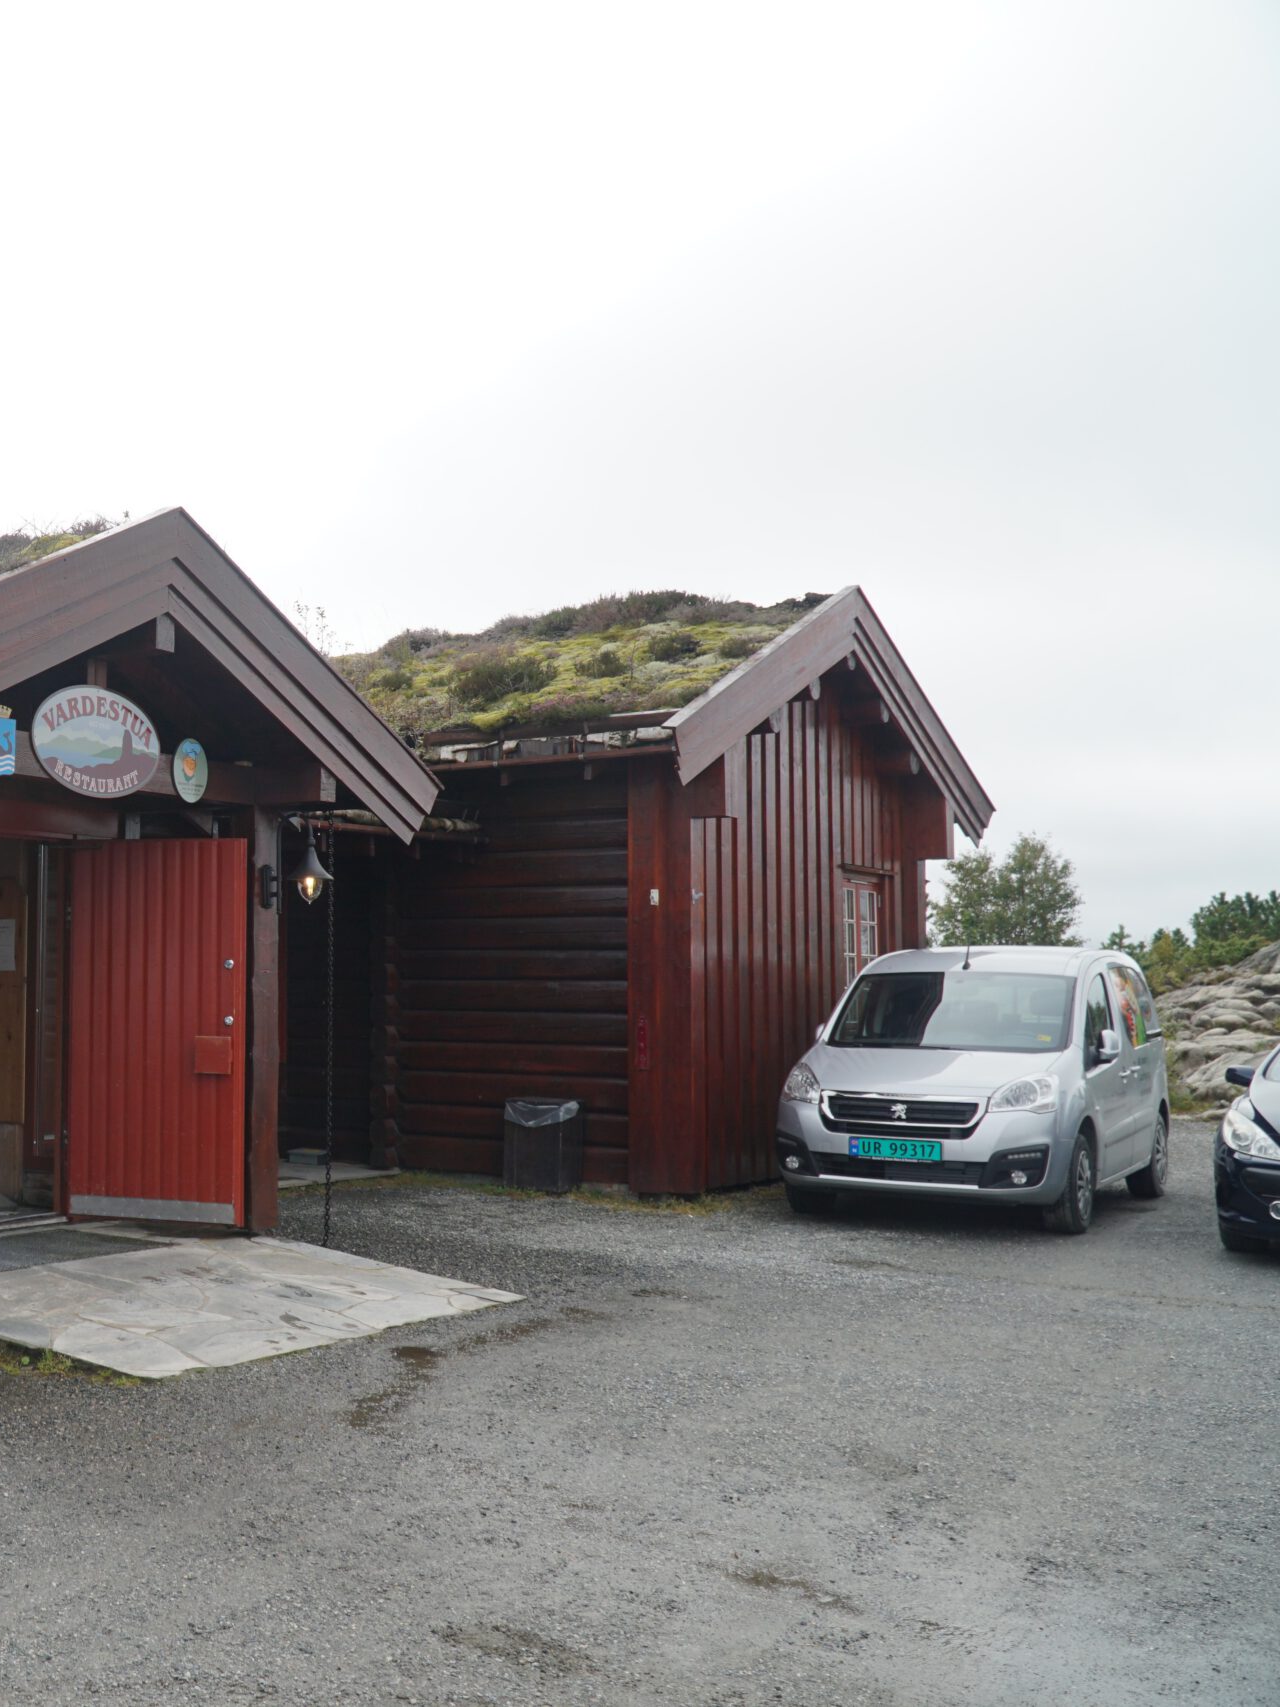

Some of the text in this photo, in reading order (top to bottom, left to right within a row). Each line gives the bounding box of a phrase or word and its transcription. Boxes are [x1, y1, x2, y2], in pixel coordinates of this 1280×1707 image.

[42, 695, 152, 750] VARDESTUA
[54, 759, 139, 793] RESTAURANT
[862, 1140, 934, 1158] UR 99317
